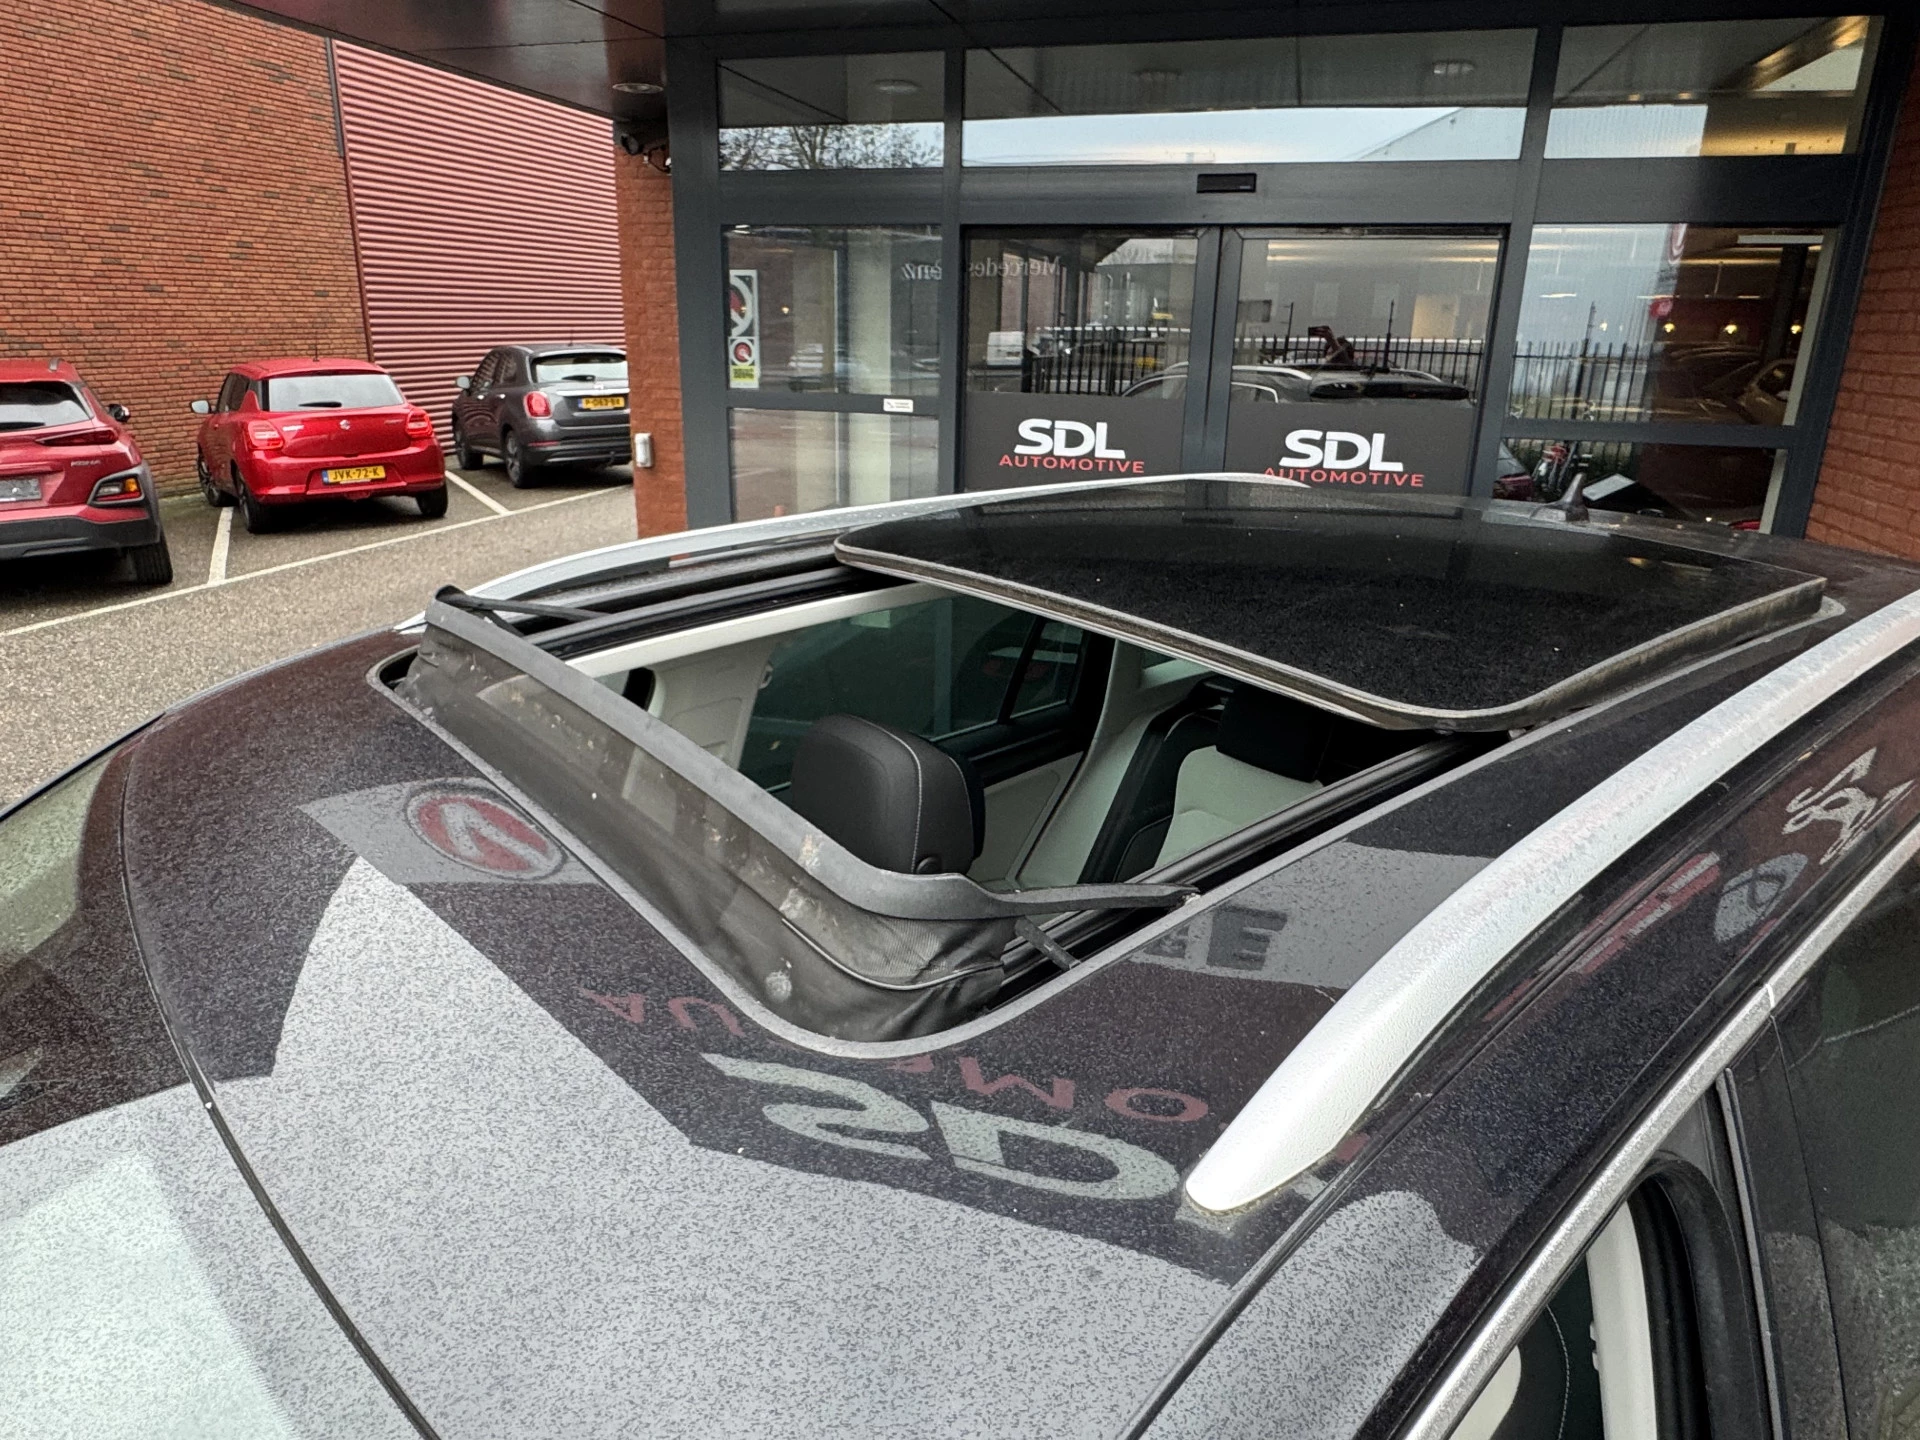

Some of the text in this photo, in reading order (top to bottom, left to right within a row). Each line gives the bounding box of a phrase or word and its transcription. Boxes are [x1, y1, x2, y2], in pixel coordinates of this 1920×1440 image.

[1013, 418, 1126, 459] SDL
[1278, 429, 1404, 472] SDL
[333, 466, 380, 481] JVK-72-K
[999, 454, 1145, 474] AUTOMOTIVE
